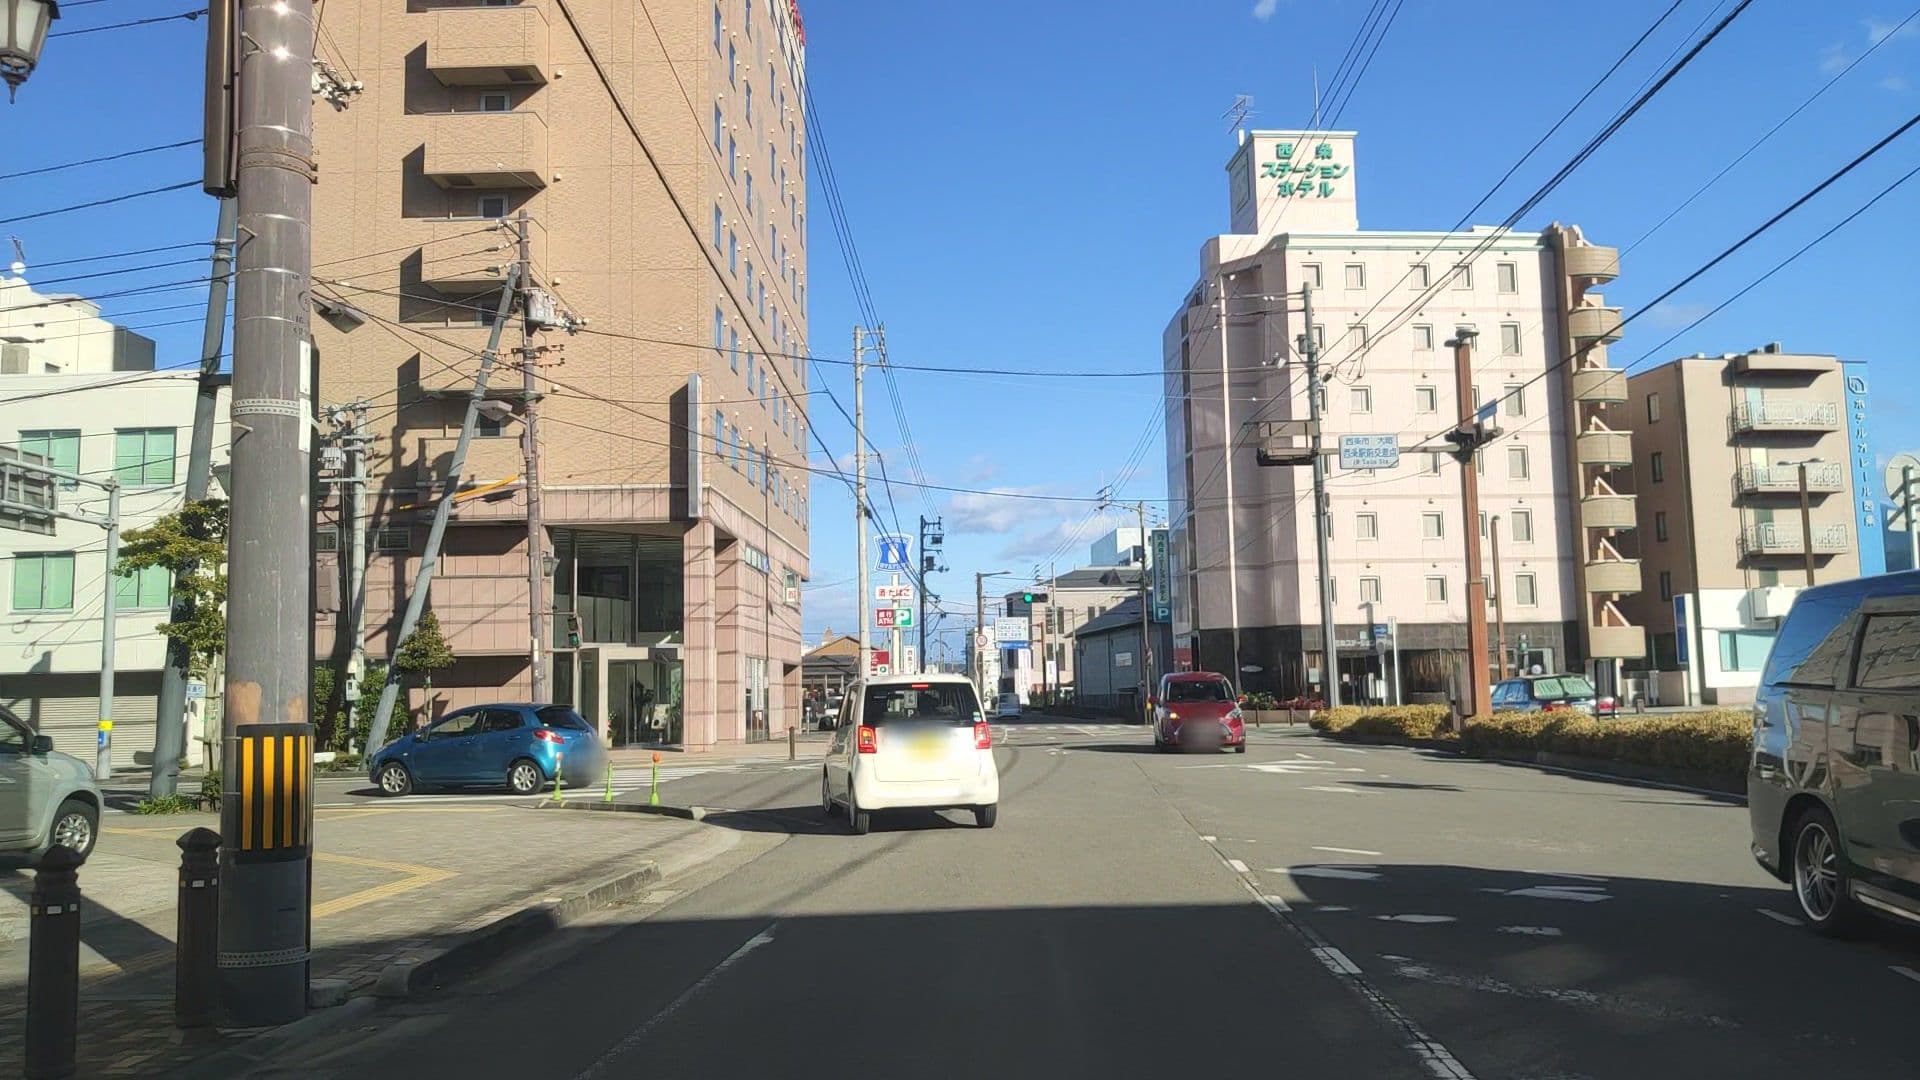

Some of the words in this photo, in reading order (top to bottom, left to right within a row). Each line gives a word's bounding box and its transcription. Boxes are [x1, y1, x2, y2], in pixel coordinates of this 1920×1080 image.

[1260, 162, 1350, 179] ステーション
[1277, 181, 1335, 198] ホテル
[1345, 437, 1369, 445] 西条市
[895, 608, 911, 626] P
[1158, 608, 1169, 620] P
[877, 618, 893, 626] ATM
